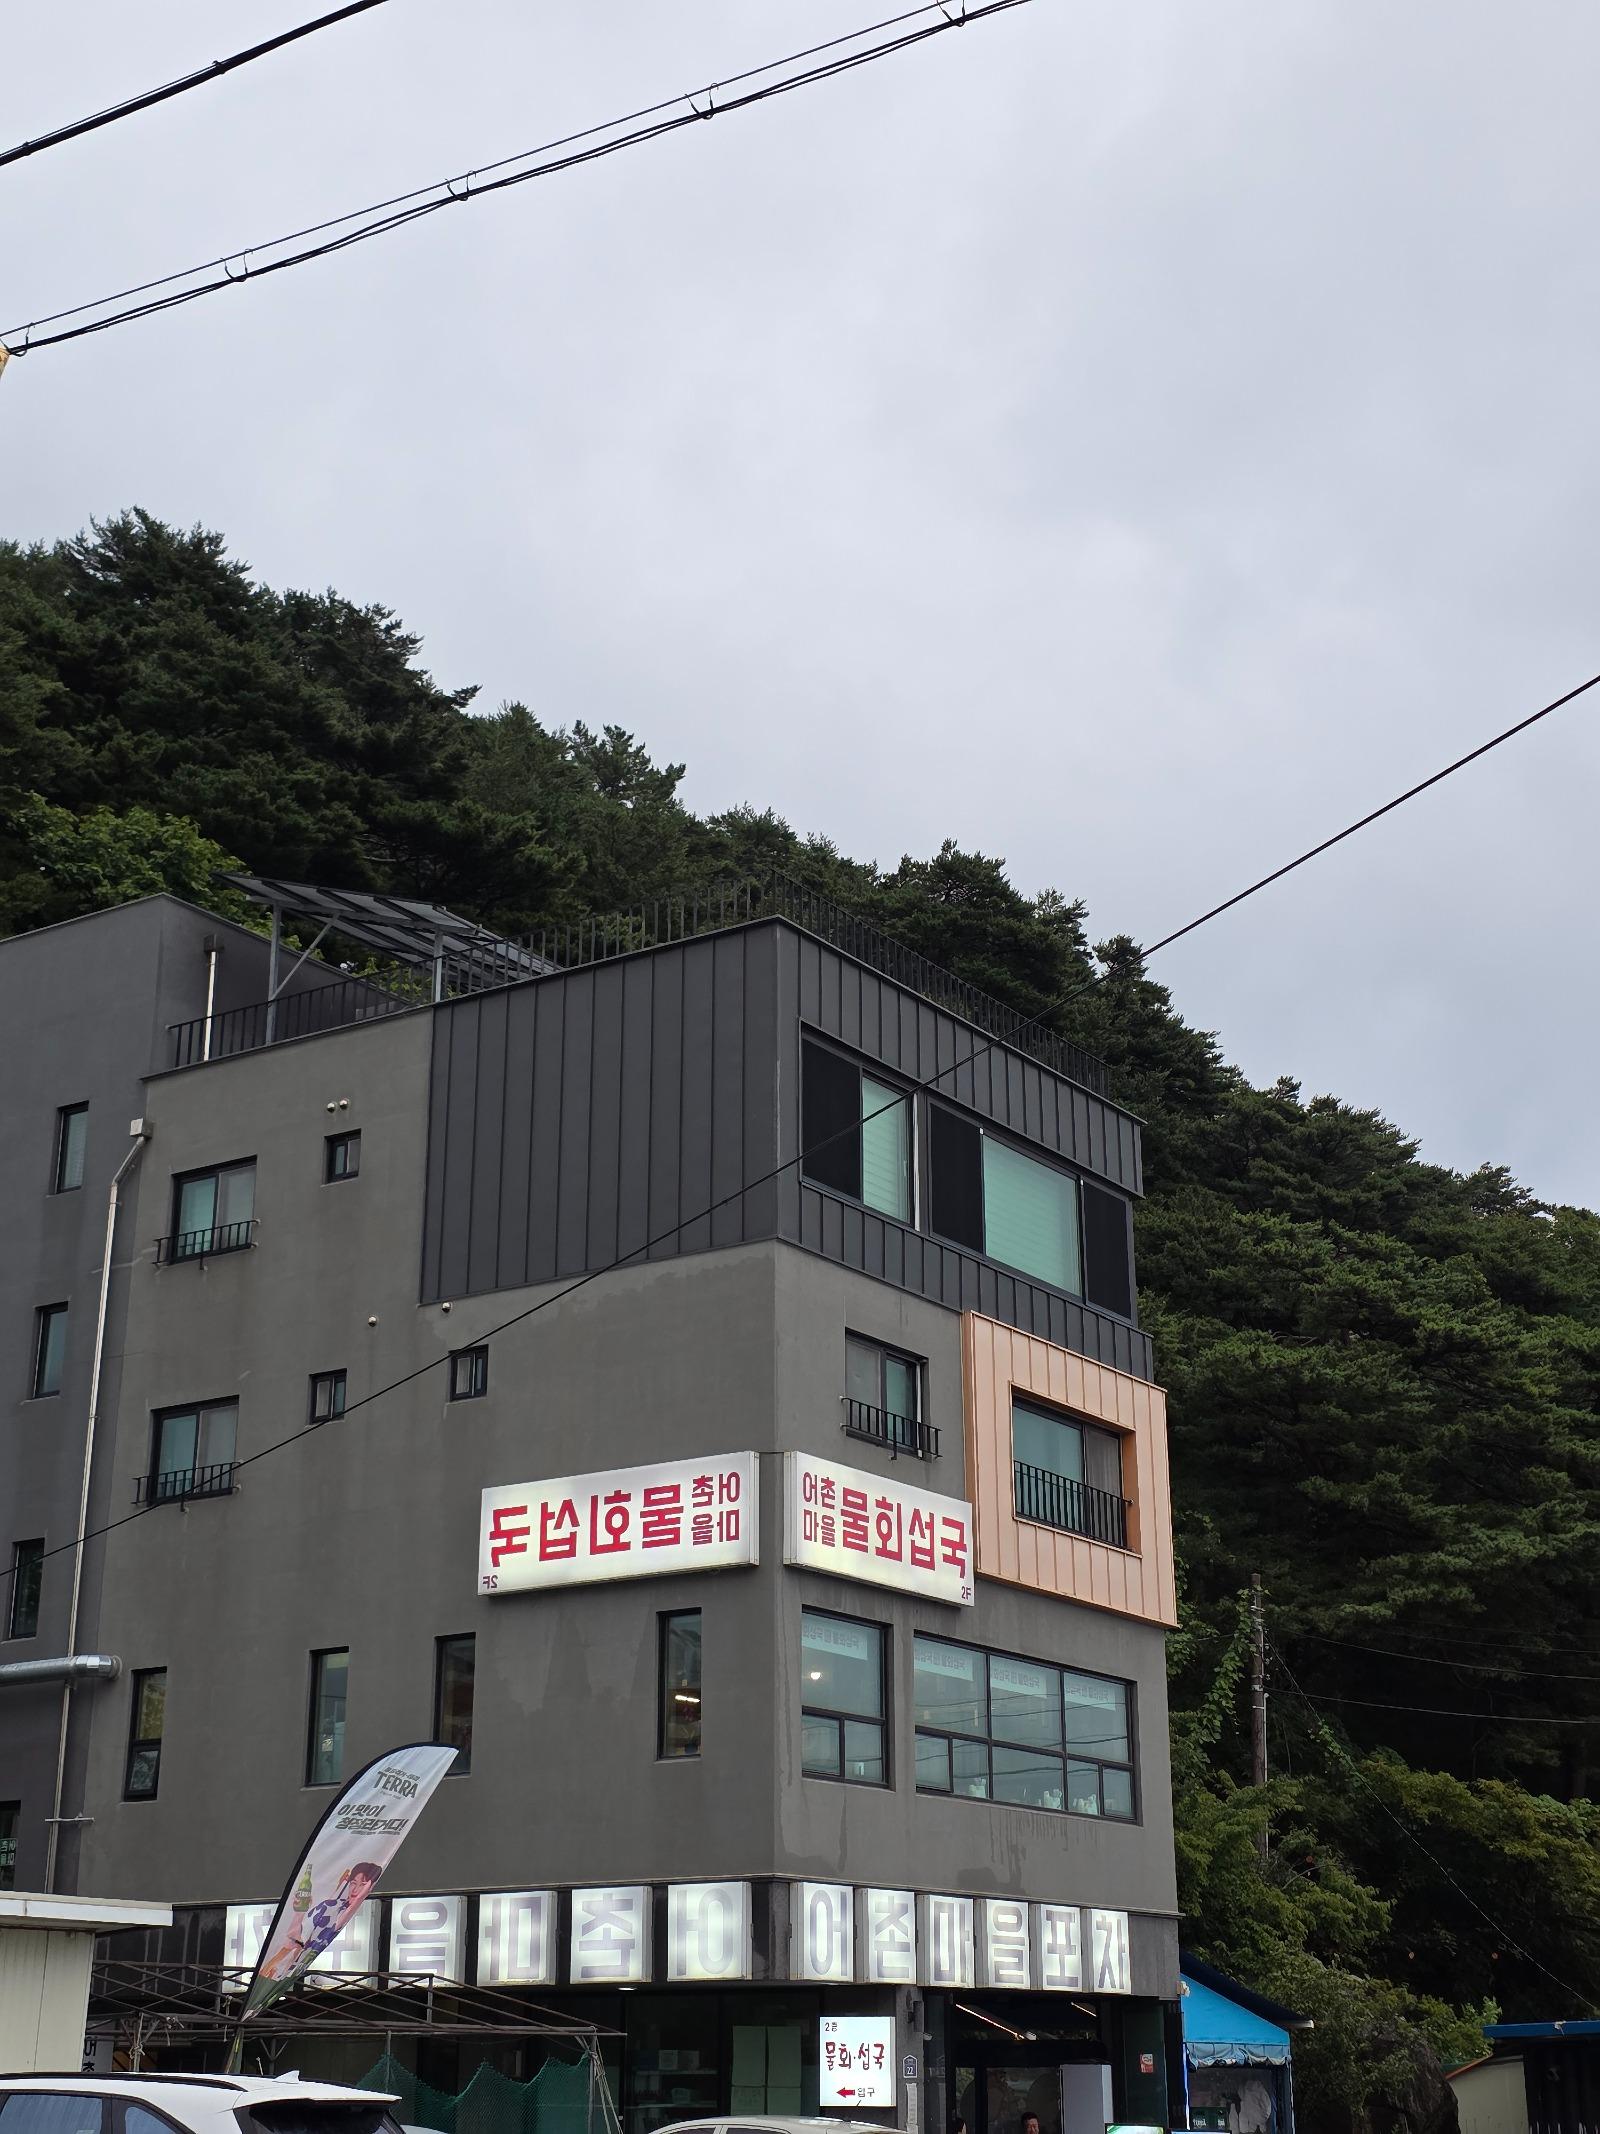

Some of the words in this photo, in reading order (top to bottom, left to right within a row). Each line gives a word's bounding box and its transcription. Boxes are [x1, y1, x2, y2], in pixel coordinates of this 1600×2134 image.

[803, 1471, 836, 1509] 어촌
[803, 1509, 836, 1547] 마을
[841, 1487, 969, 1579] 물회섭국
[961, 1585, 973, 1601] 2F
[373, 1771, 419, 1798] TERRA
[906, 2066, 915, 2075] 22
[857, 2087, 876, 2098] 입구
